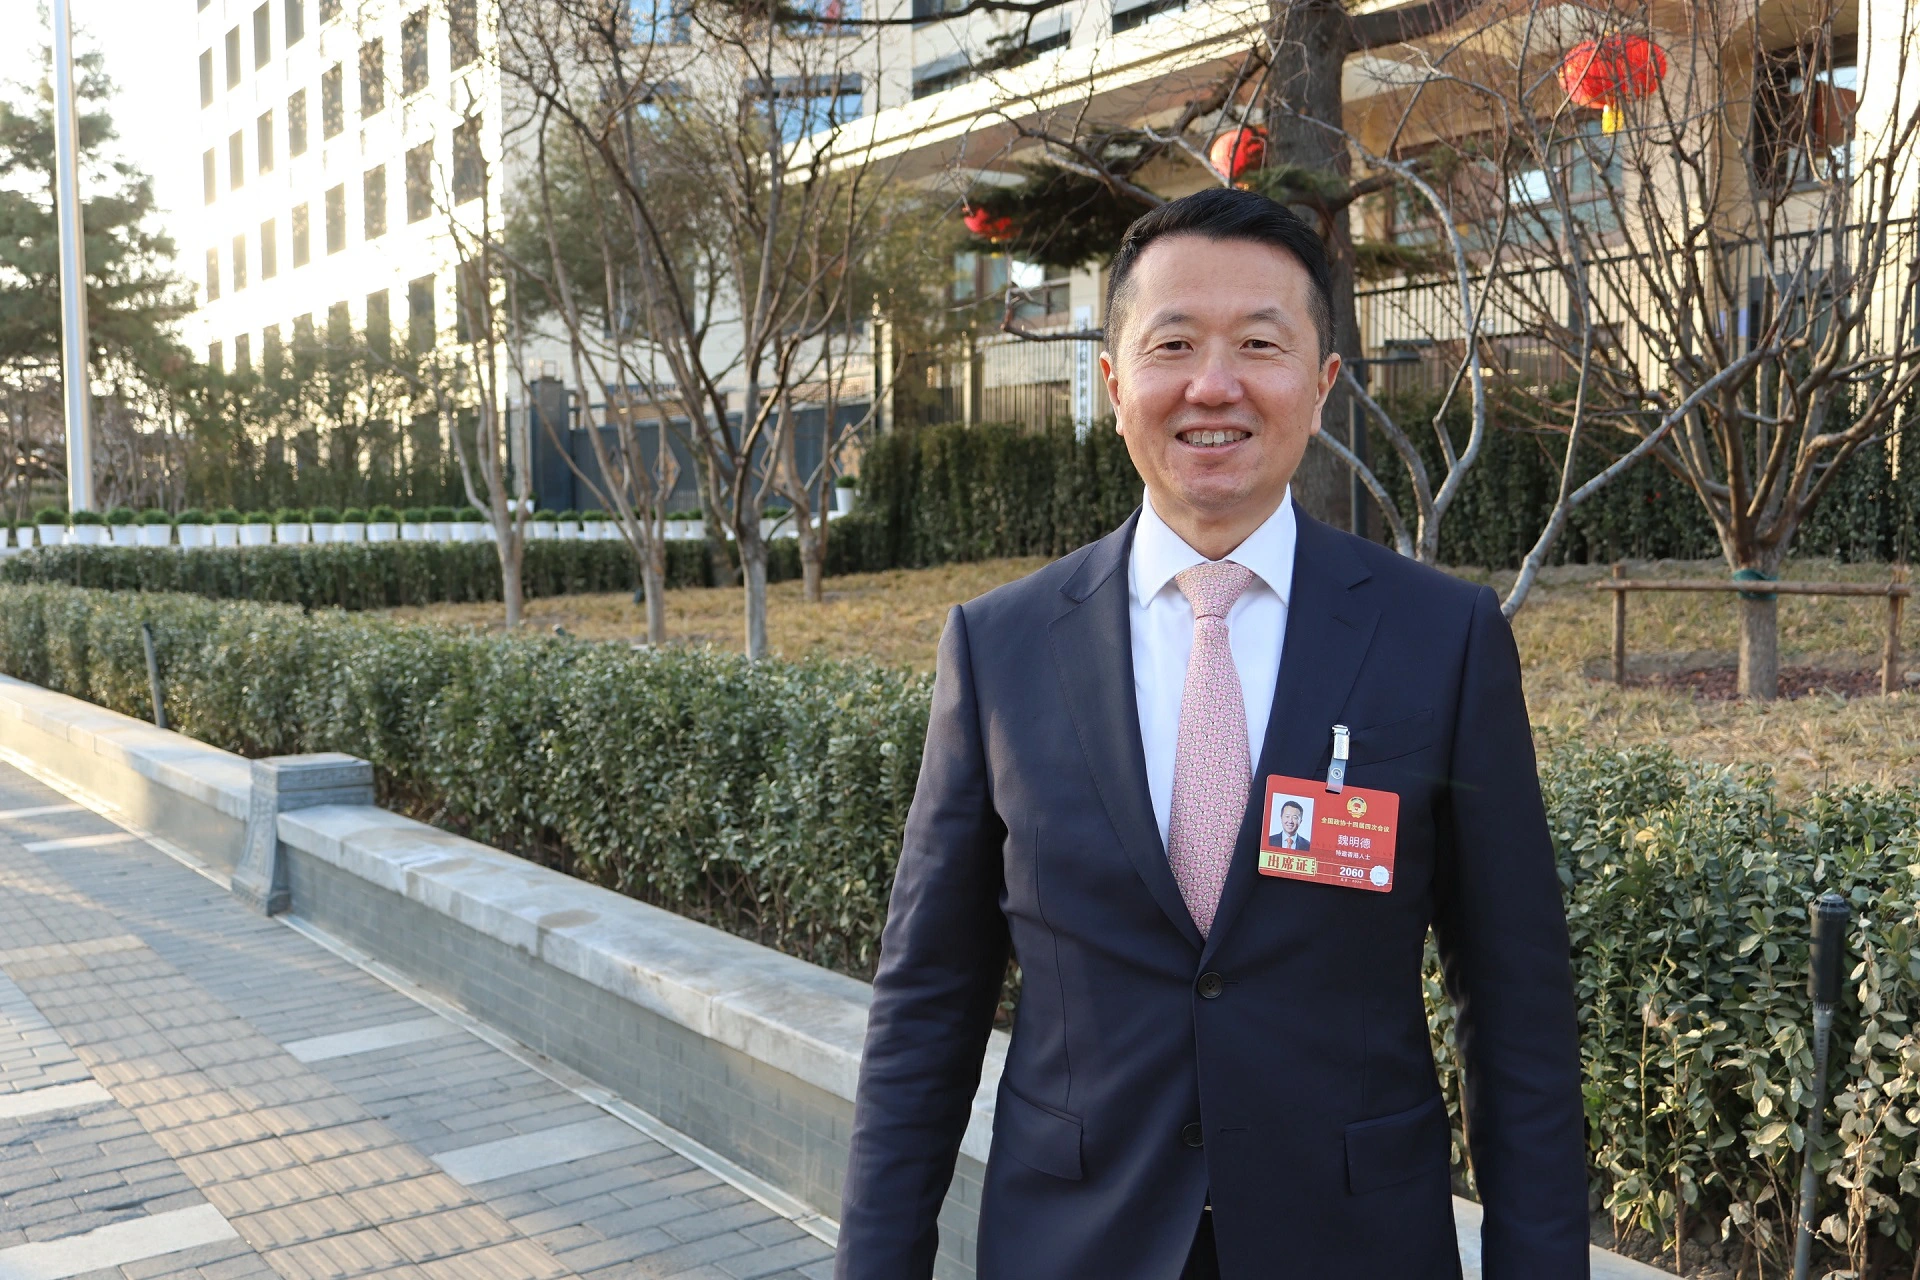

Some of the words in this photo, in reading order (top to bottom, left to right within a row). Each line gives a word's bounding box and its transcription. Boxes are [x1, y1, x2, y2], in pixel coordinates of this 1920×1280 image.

[1321, 817, 1390, 833] 全国政协十四届四次会议
[1338, 834, 1371, 849] 魏明德
[1335, 849, 1371, 860] 特邀香港人士
[1267, 854, 1308, 872] 出席证
[1339, 866, 1364, 878] 2060
